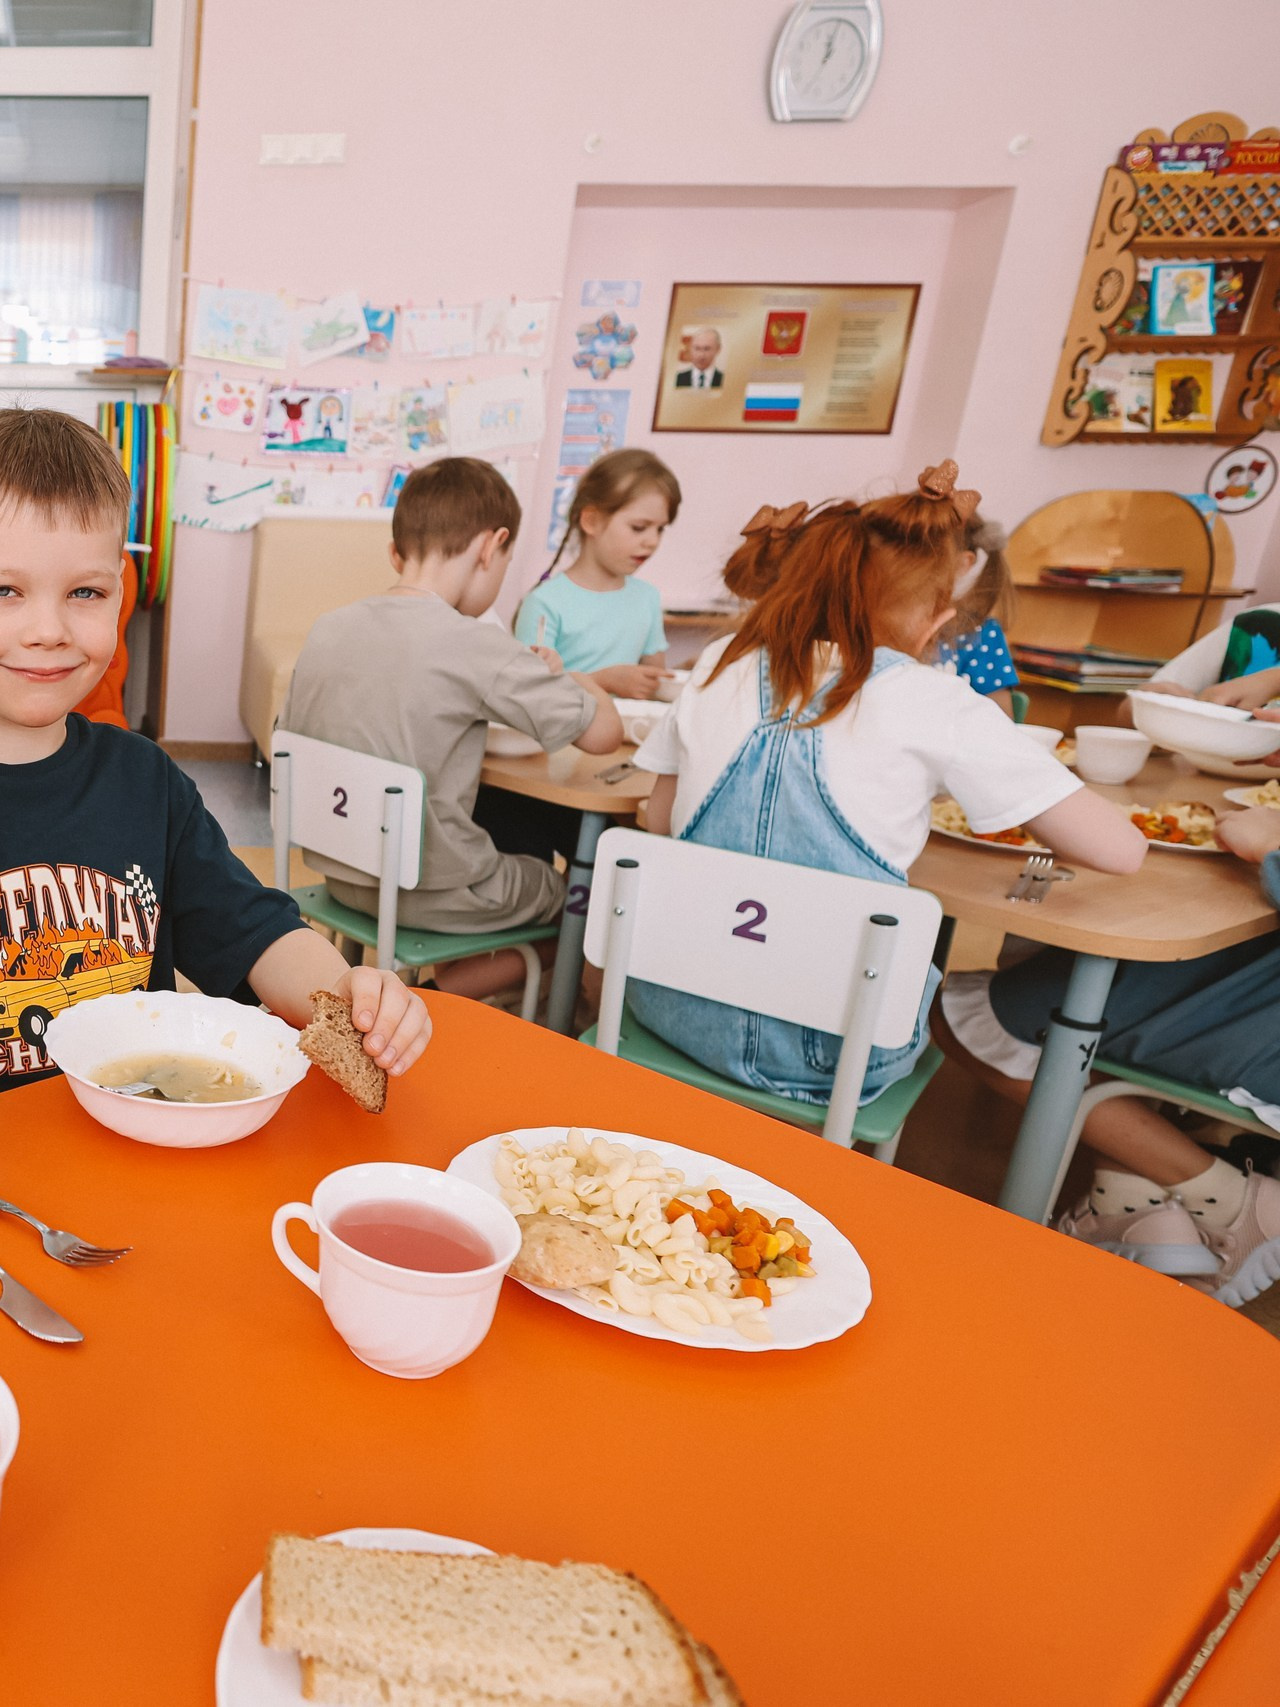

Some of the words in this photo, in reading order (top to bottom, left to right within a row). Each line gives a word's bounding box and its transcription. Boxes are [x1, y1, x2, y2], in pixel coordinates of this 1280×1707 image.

[332, 786, 348, 819] 2
[566, 884, 591, 917] 2
[732, 899, 767, 943] 2
